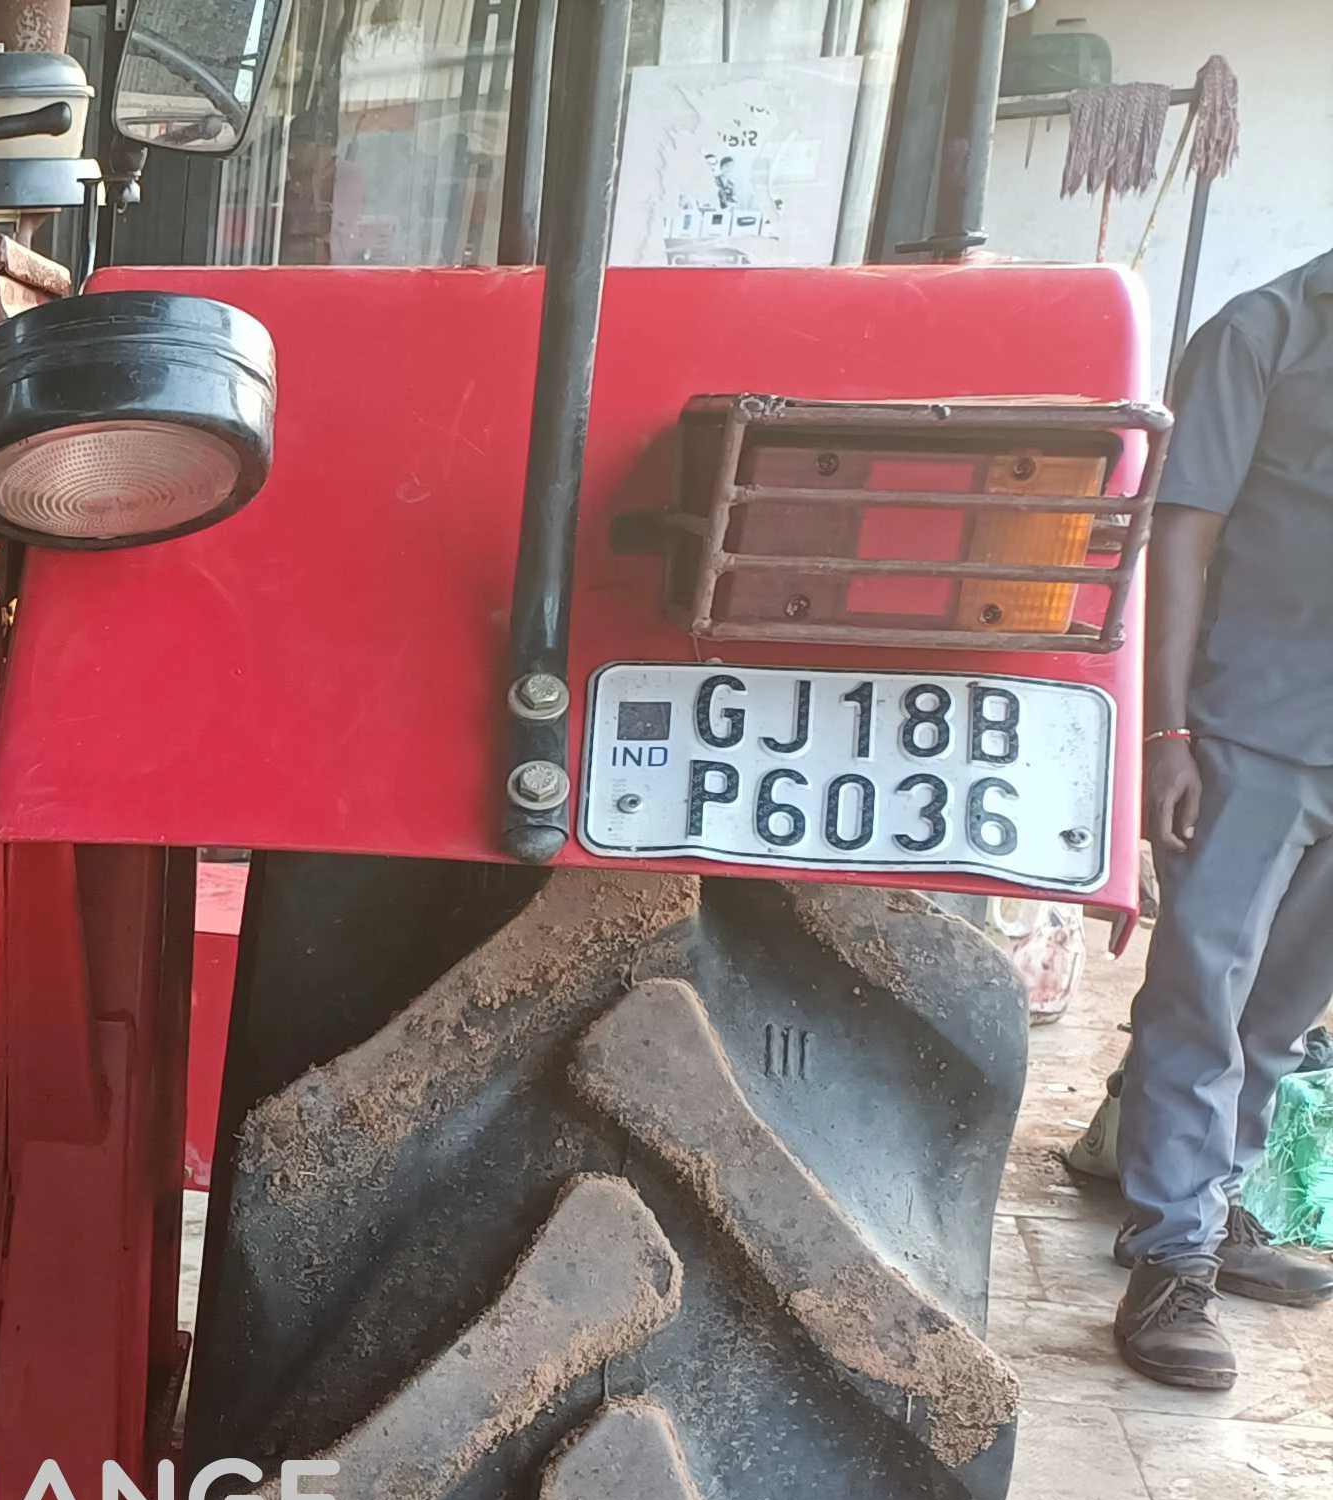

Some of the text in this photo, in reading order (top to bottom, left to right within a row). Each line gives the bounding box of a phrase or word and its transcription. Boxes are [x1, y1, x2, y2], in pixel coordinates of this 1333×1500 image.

[611, 746, 669, 767] IND
[694, 674, 1021, 765] GJ18B
[685, 759, 1020, 856] P6036
